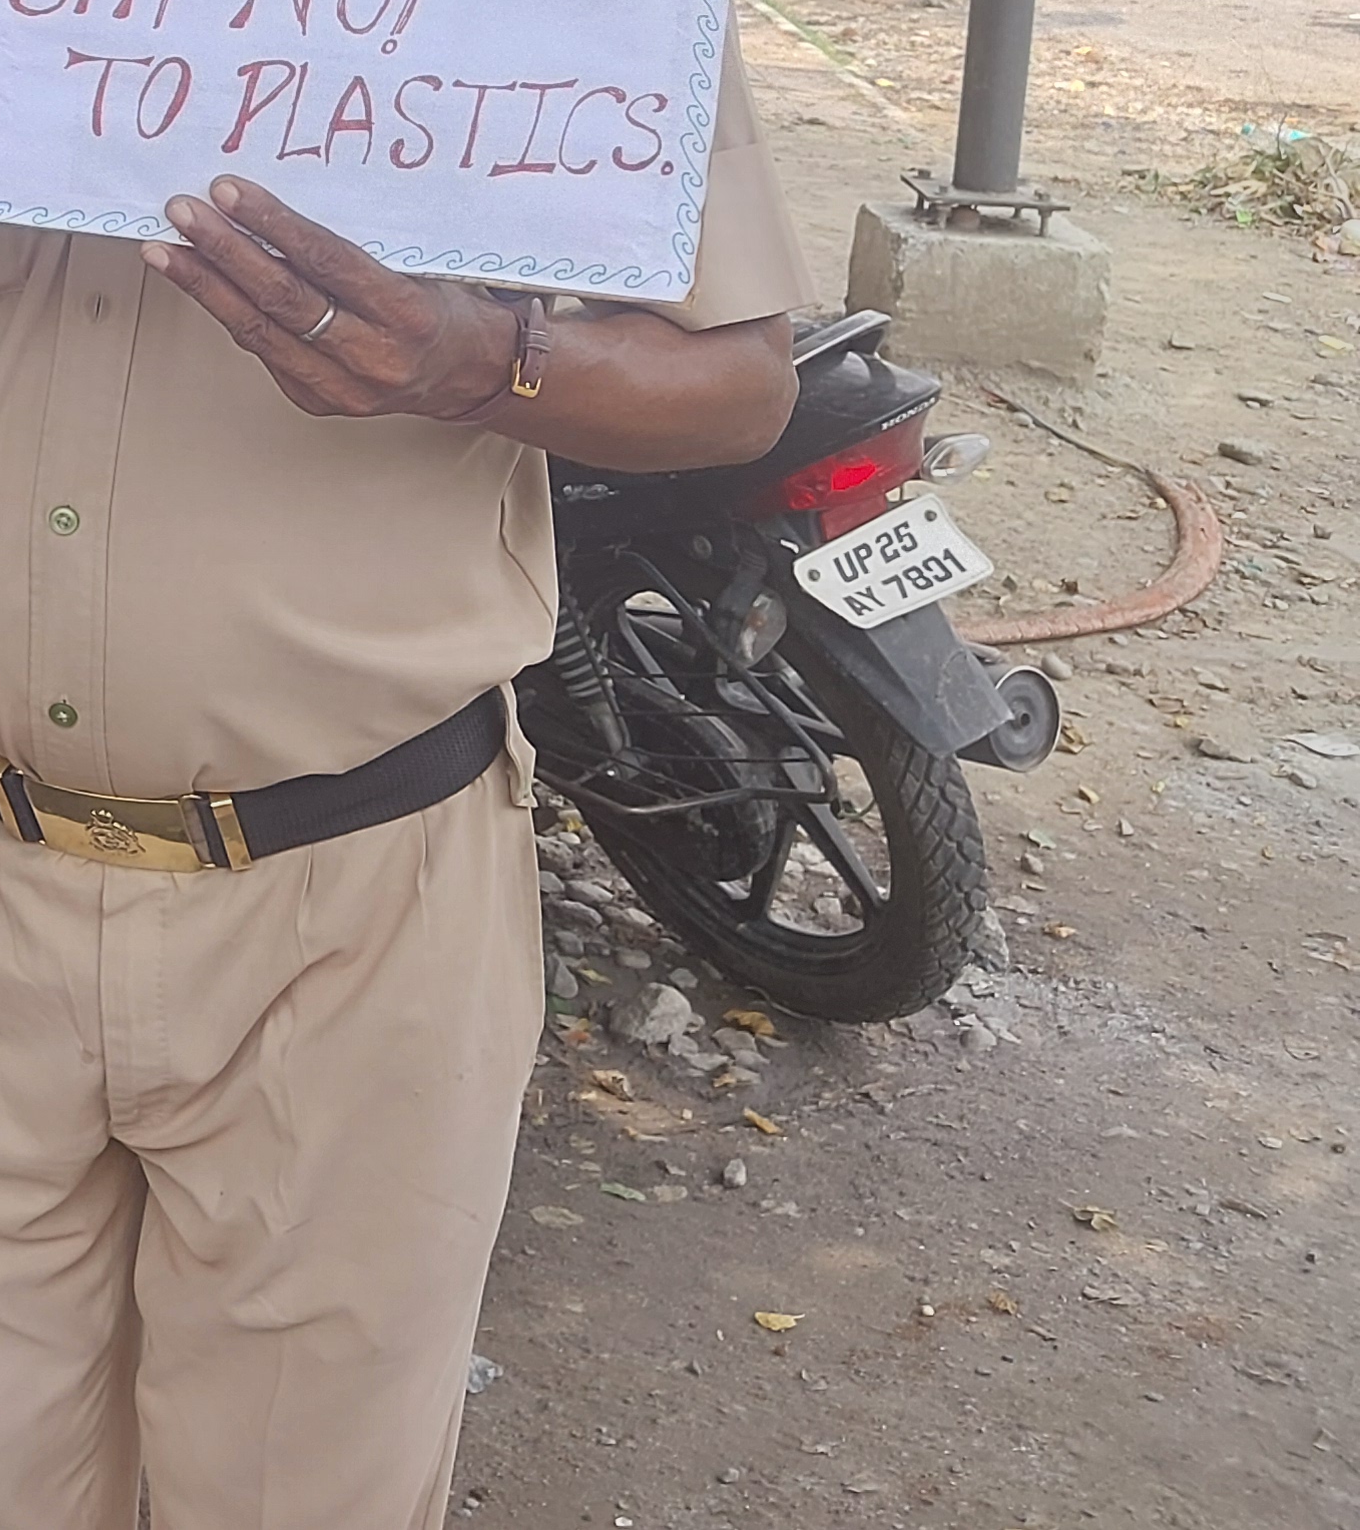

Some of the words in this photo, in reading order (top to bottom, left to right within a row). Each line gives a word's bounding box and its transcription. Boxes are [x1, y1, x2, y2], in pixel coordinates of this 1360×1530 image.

[65, 48, 192, 141] TO
[220, 59, 675, 178] PLASTICS.
[881, 397, 936, 431] HONDA
